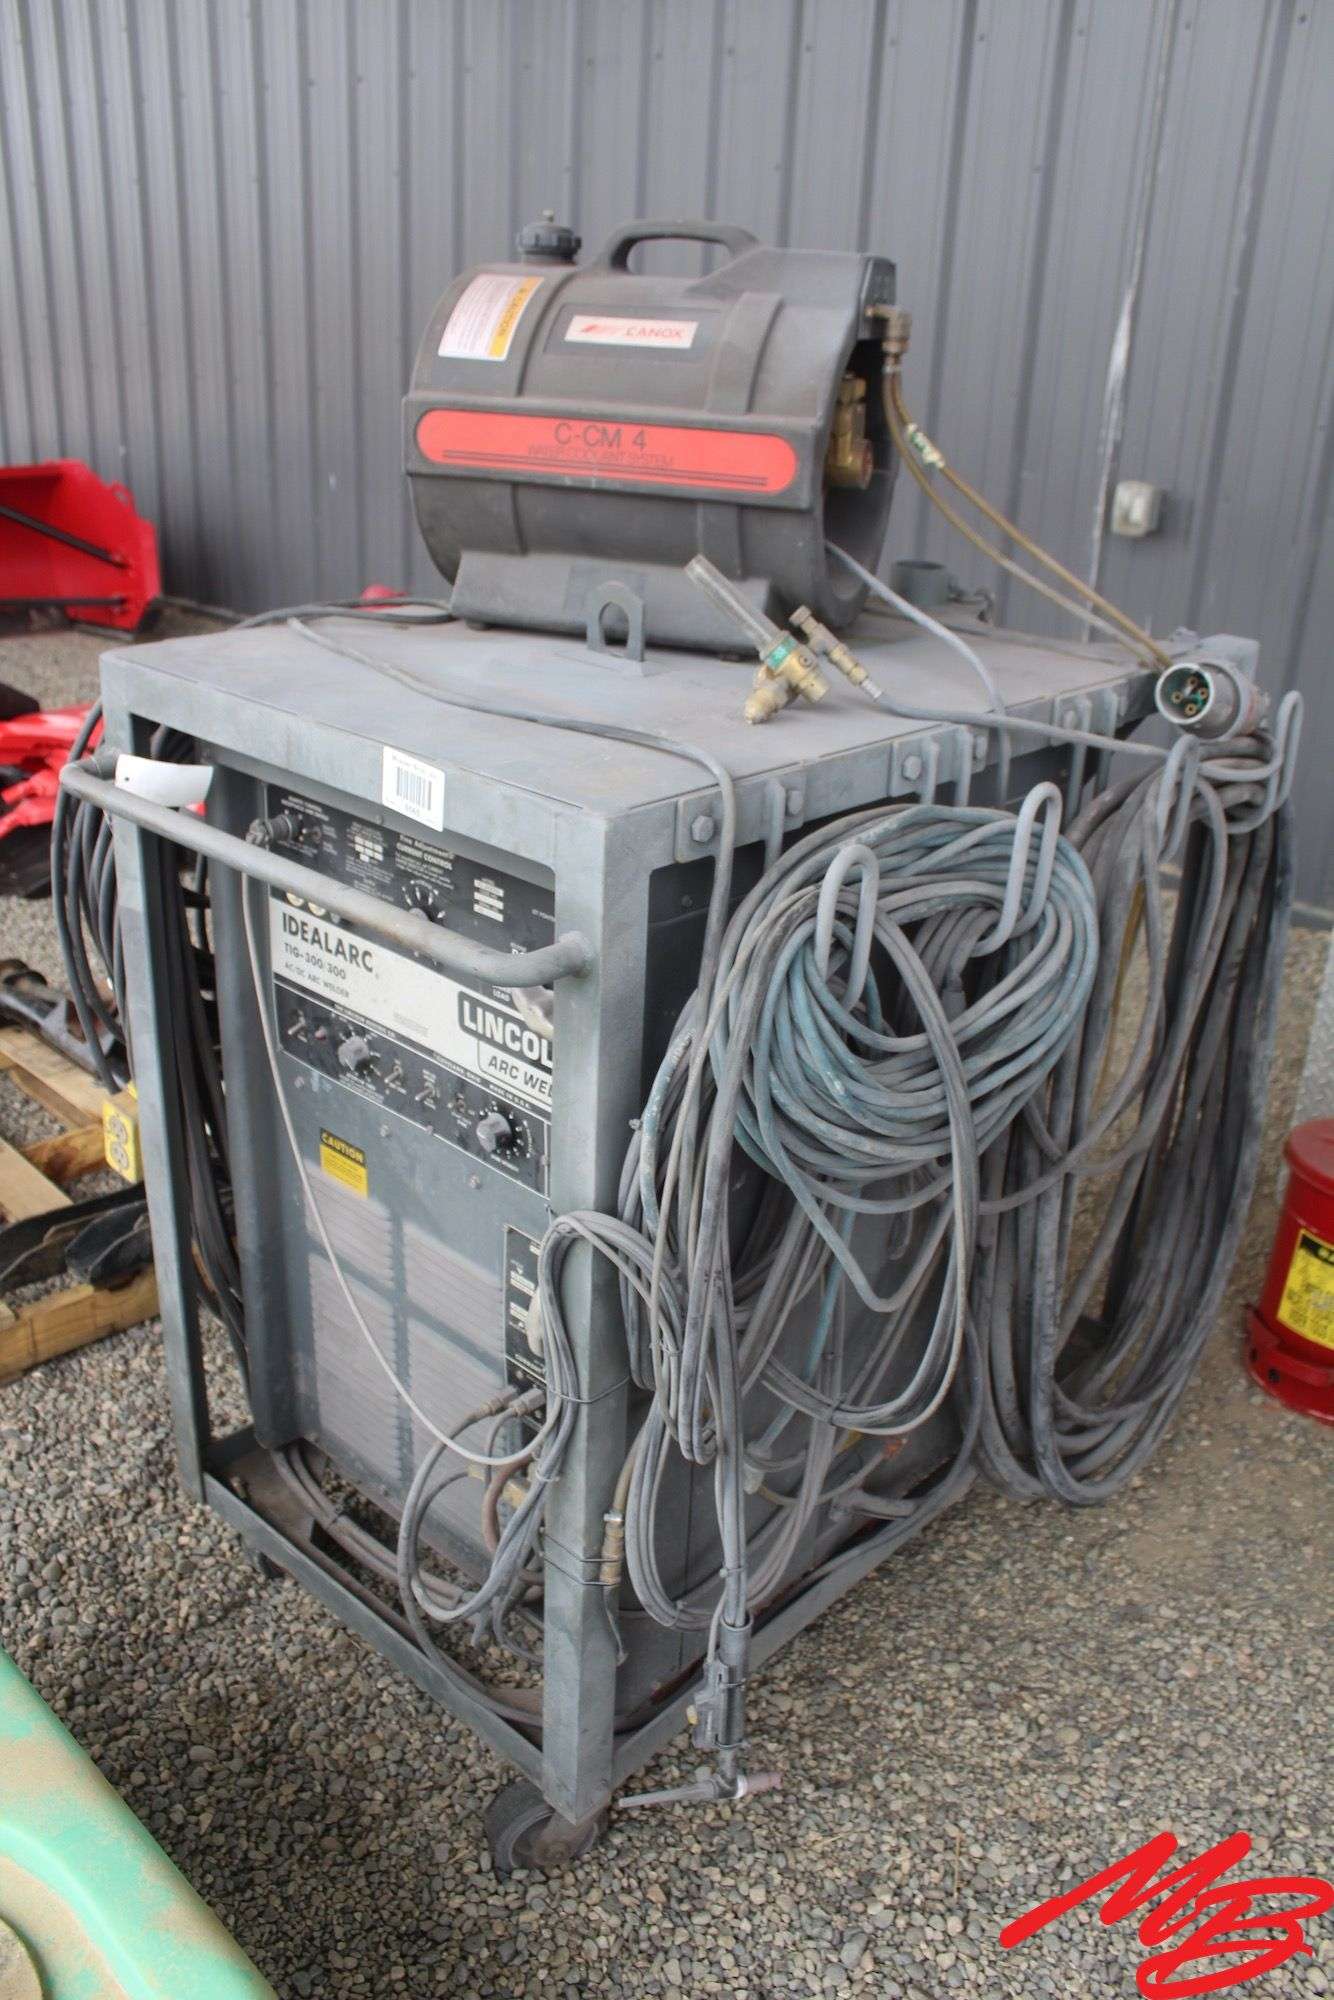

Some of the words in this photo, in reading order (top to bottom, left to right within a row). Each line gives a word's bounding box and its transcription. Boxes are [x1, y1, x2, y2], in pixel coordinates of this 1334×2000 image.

[555, 422, 621, 448] C-CM
[633, 429, 647, 450] 4
[282, 912, 374, 973] IDEALARC
[463, 1001, 553, 1068] LINCOL
[488, 1055, 519, 1080] ARC
